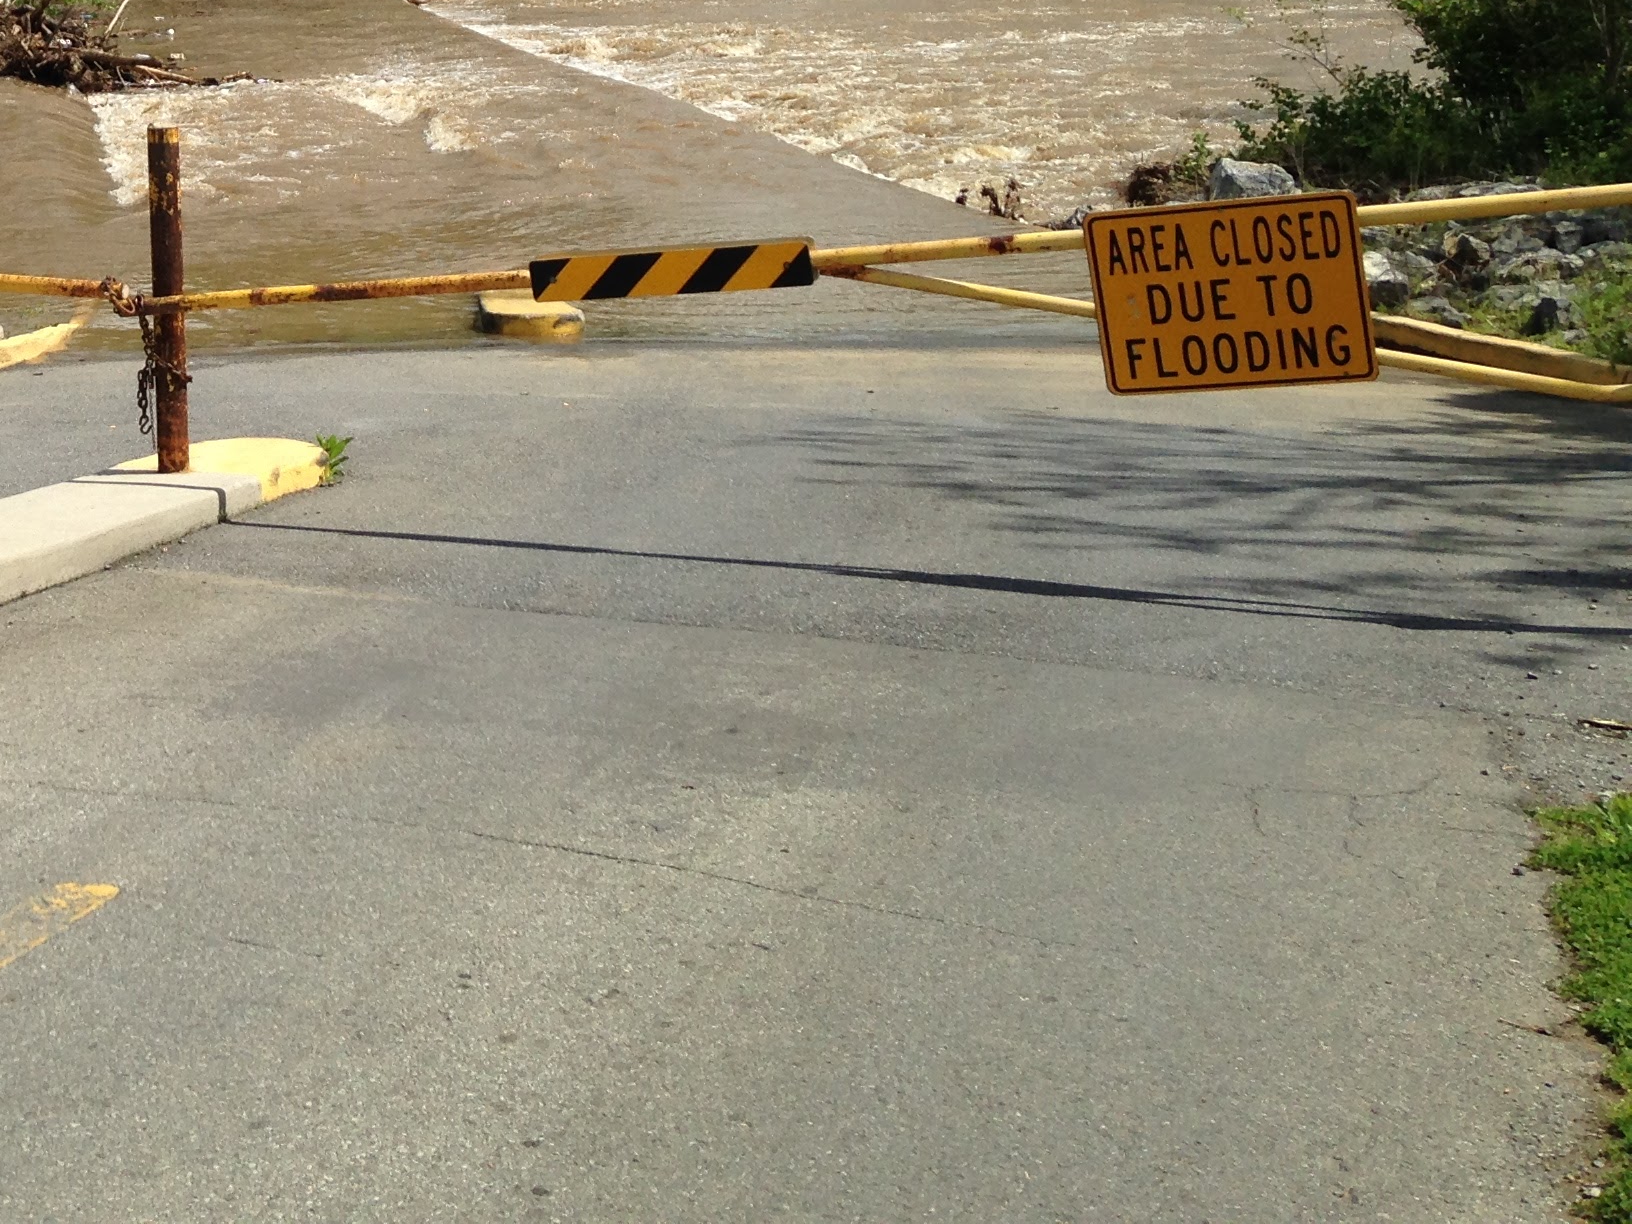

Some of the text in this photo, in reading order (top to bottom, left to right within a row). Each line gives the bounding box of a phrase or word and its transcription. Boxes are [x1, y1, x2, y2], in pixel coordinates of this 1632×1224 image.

[1109, 210, 1341, 276] AREA CLOSED
[1146, 273, 1313, 325] DUE TO
[1125, 324, 1352, 380] FLOODING
